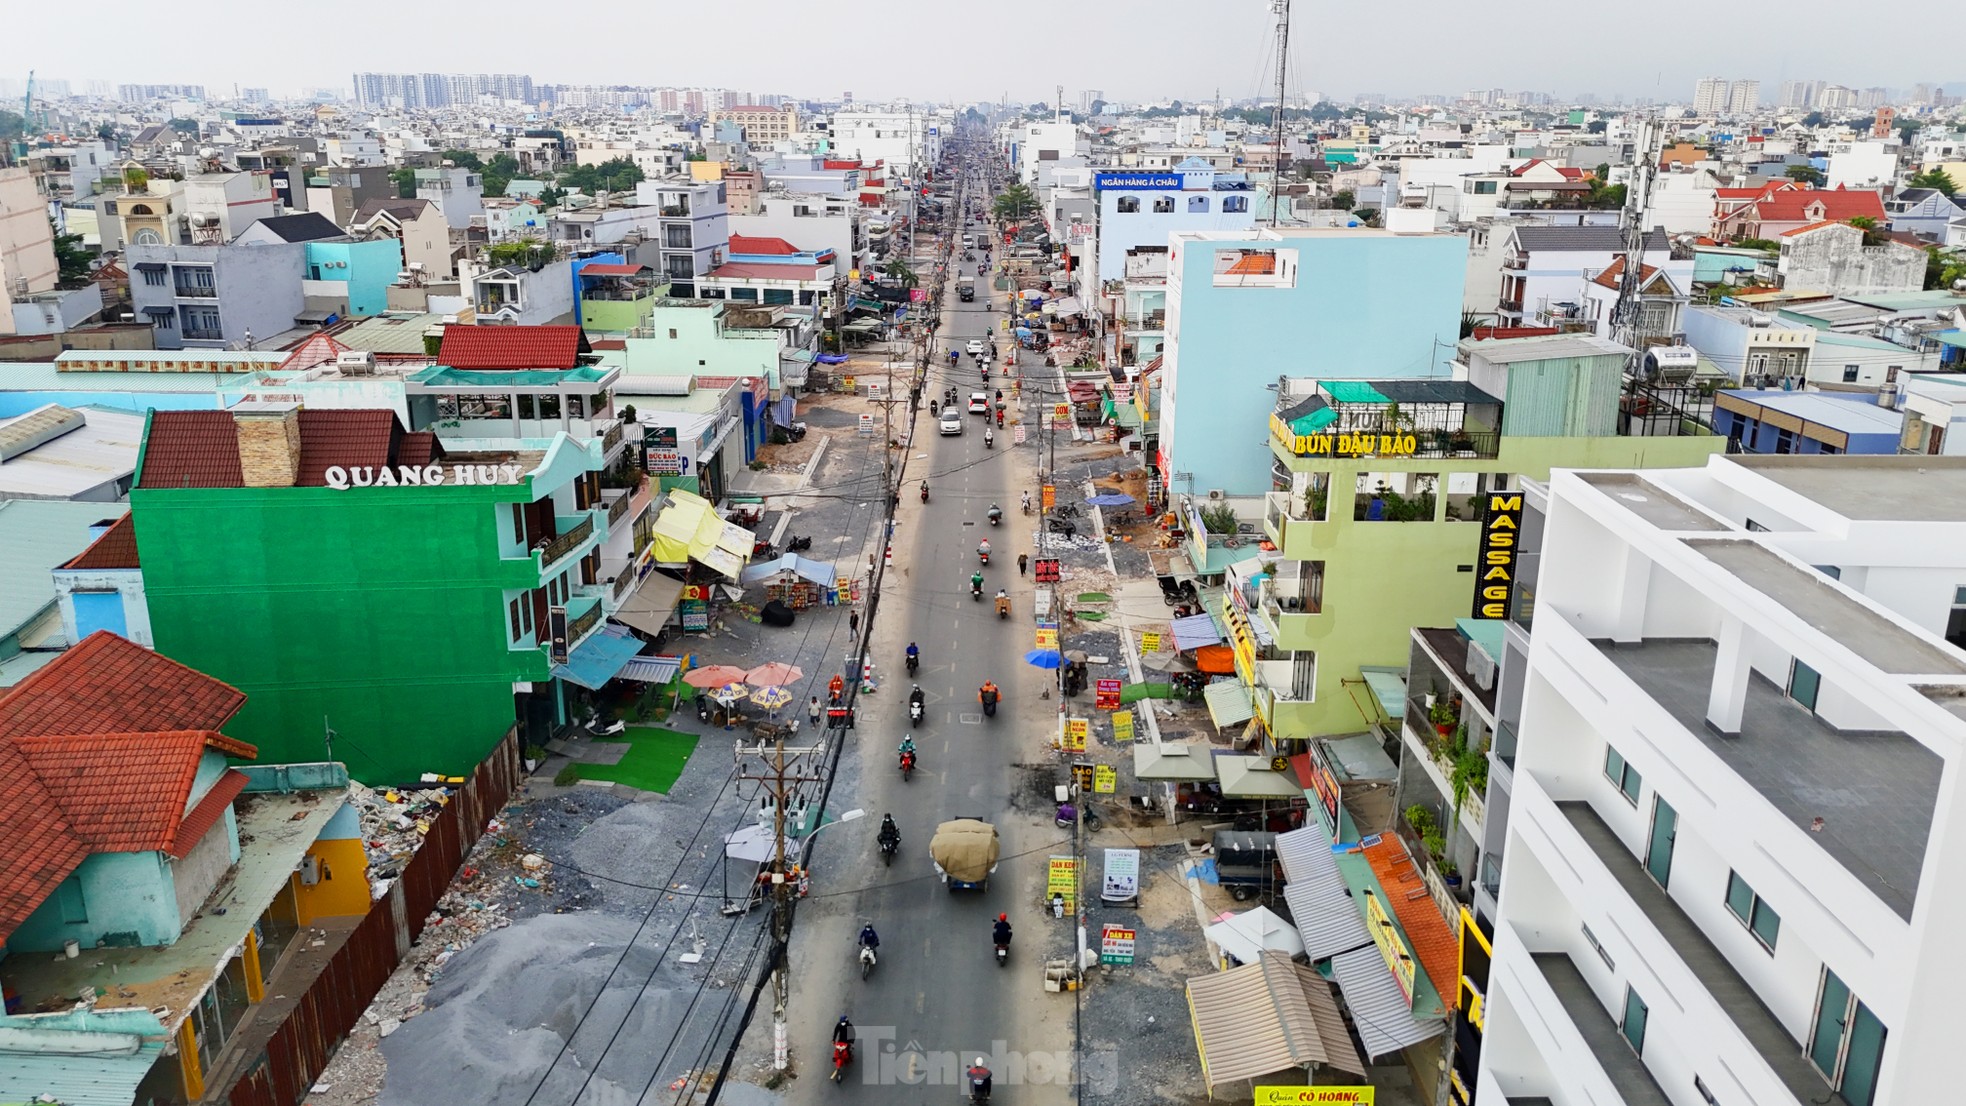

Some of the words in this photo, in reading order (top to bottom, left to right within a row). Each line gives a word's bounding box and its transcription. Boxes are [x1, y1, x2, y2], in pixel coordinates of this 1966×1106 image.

[1101, 177, 1123, 187] NGÂN
[1124, 176, 1148, 187] HÀNG
[1148, 176, 1155, 187] Á
[1155, 177, 1178, 187] CHÂU
[1294, 429, 1333, 454] BÚN
[1337, 429, 1375, 459] ĐẬU
[1380, 427, 1417, 454] BẢO
[325, 465, 446, 491] QUANG
[453, 464, 523, 486] HUY
[1482, 496, 1522, 618] MASSAGE
[1298, 1089, 1315, 1102] CÔ
